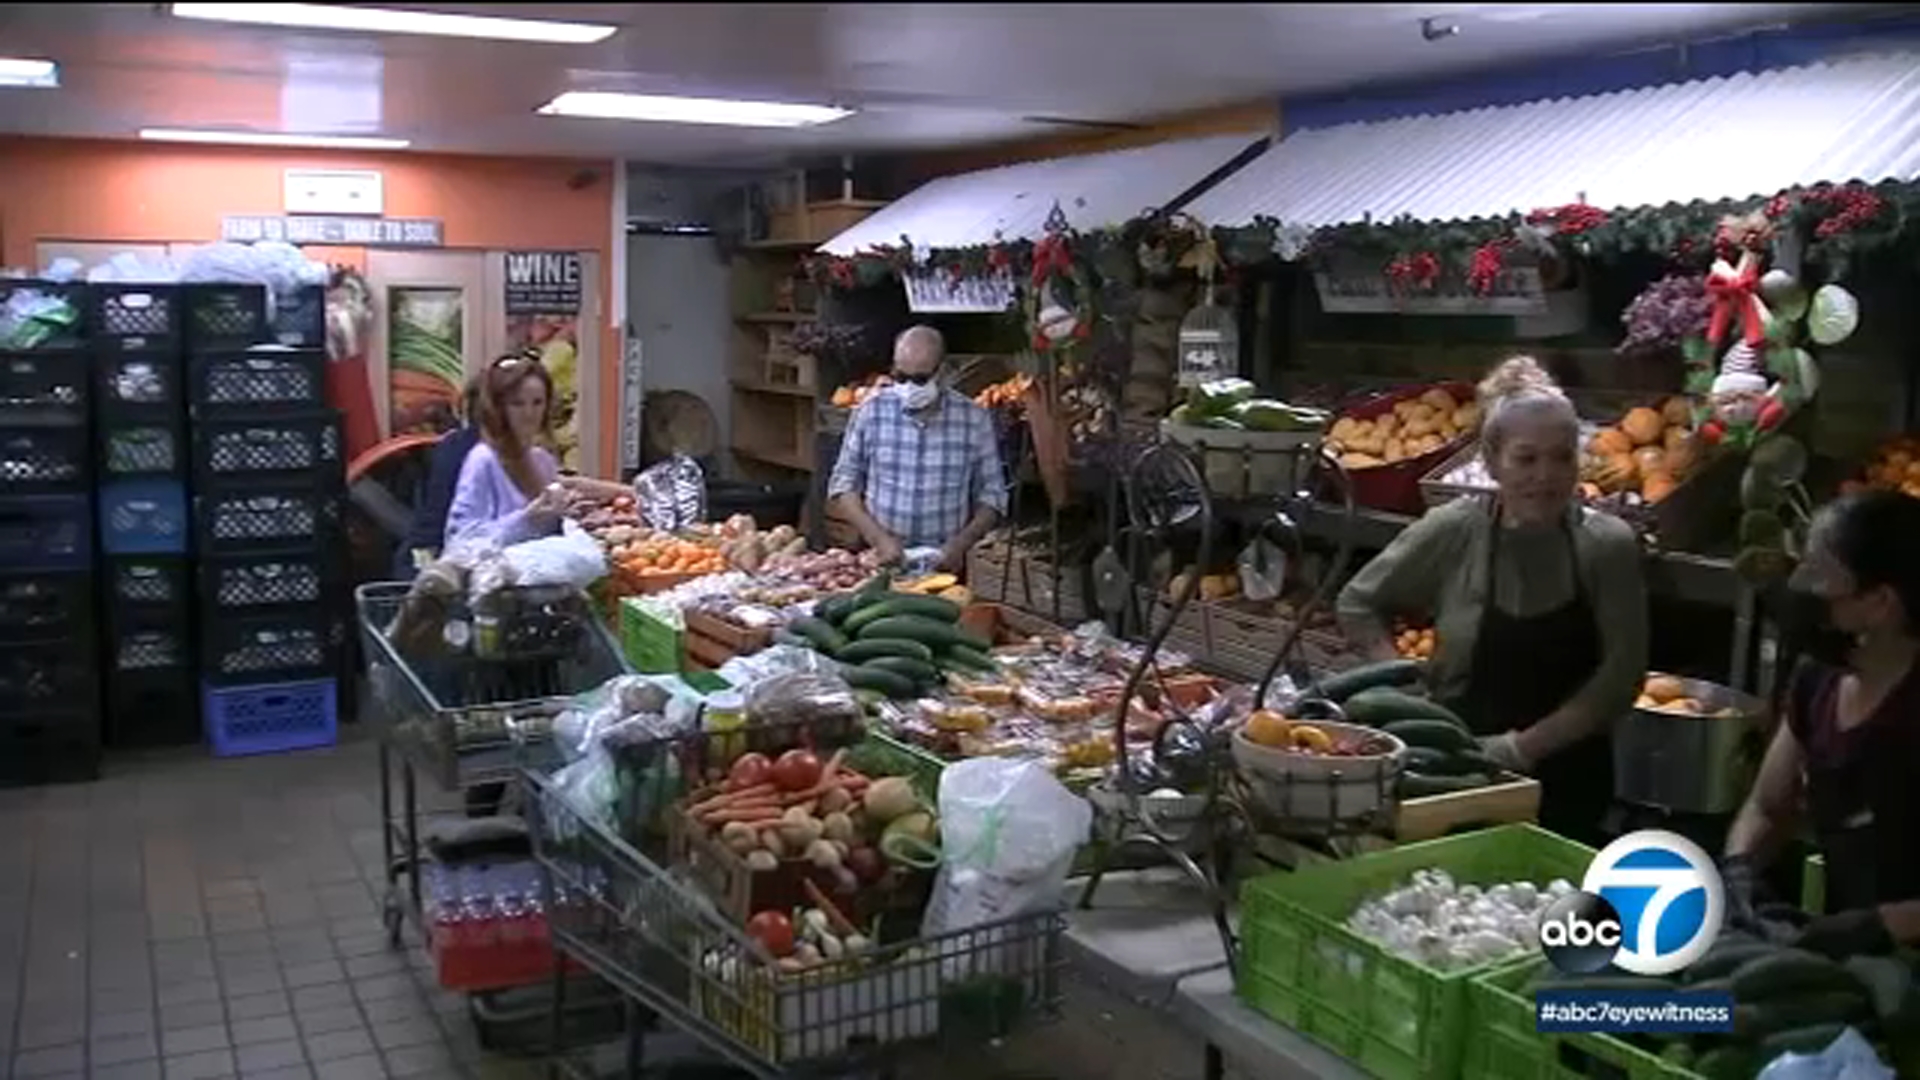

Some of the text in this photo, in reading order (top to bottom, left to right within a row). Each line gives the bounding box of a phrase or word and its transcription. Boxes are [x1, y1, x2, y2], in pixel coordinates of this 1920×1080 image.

[386, 222, 402, 242] TO
[404, 222, 437, 242] SOUL
[508, 254, 579, 283] WINE
